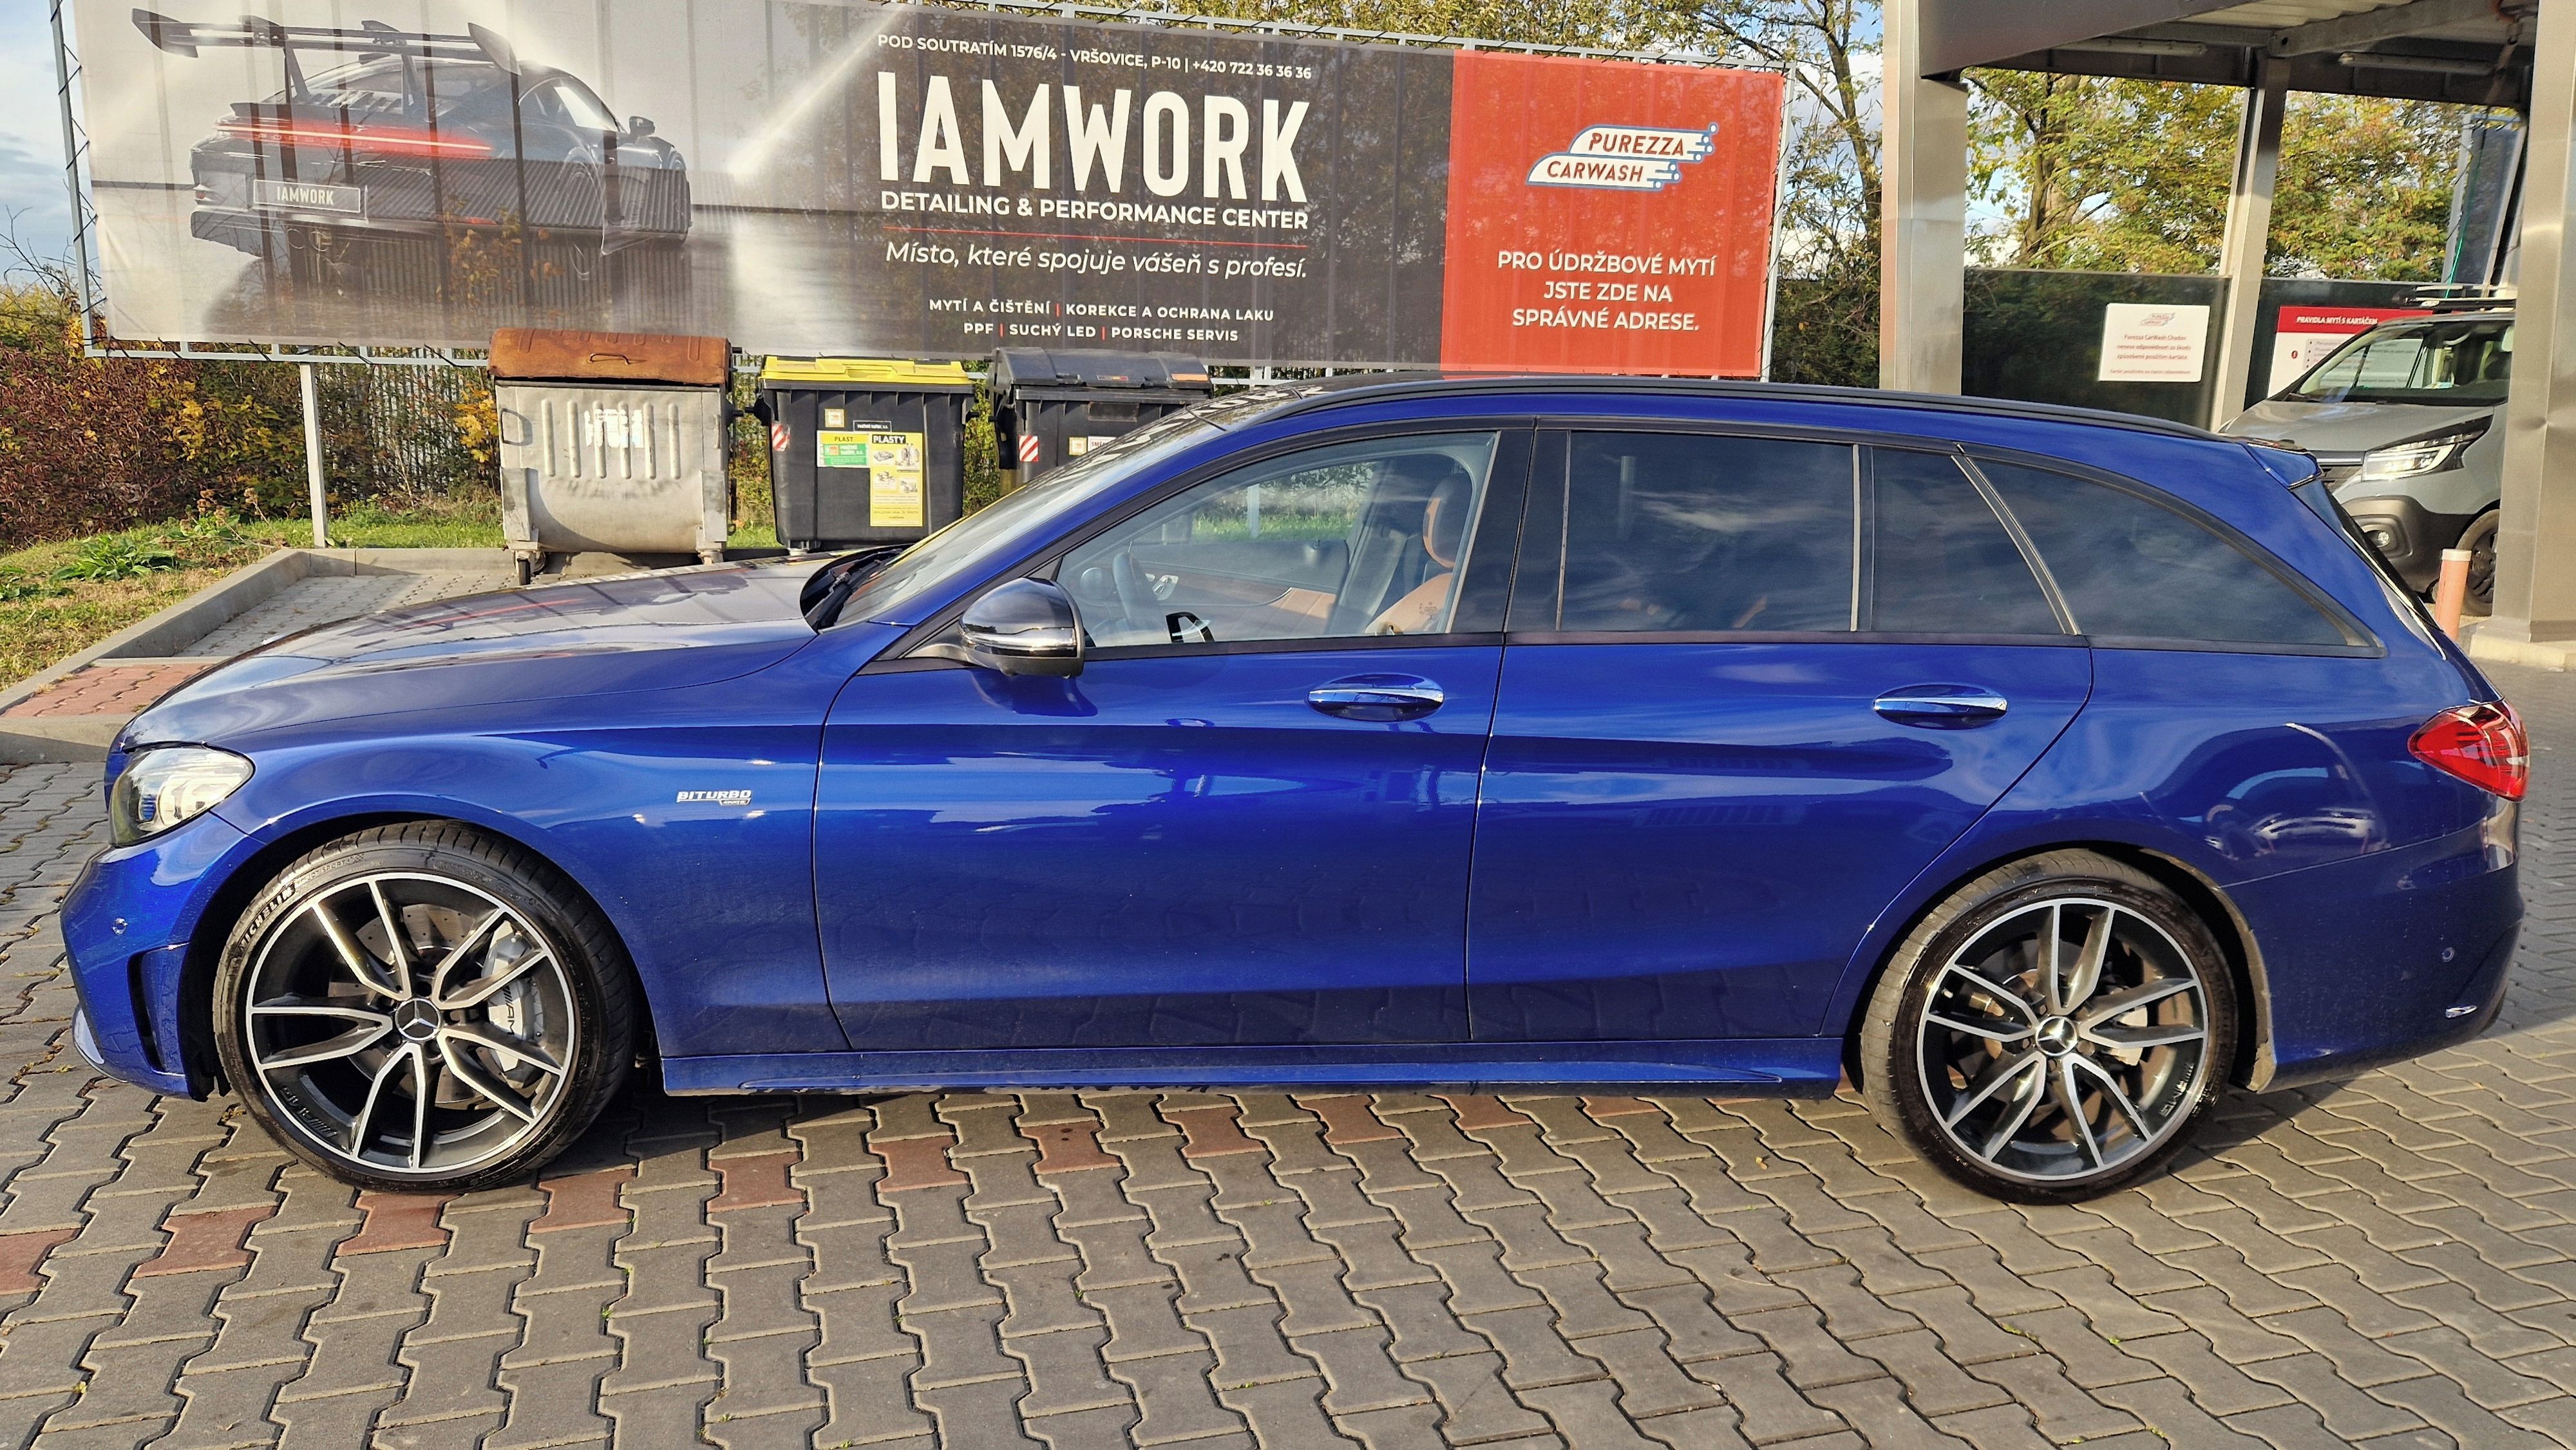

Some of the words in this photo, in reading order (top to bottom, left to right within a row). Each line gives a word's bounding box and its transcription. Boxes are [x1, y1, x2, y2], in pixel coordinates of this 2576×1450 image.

[878, 35, 913, 49] POD
[917, 37, 1007, 57] SOUTRATÍM
[1011, 44, 1057, 61] 1576/4
[1070, 48, 1148, 70] VRŠOVICE,
[1151, 56, 1181, 70] P-10
[1193, 60, 1226, 73] +420
[1229, 62, 1254, 75] 722
[1256, 63, 1273, 77] 36
[1276, 64, 1293, 78] 36
[1295, 66, 1312, 79] 36
[878, 71, 1310, 203] IAMWORK
[1589, 132, 1684, 156] PUREZZA
[1547, 160, 1643, 183] CARWASH
[276, 185, 335, 206] IAMWORK
[881, 191, 1010, 216] DETAILING
[1017, 199, 1034, 216] &
[1040, 199, 1217, 226] PERFORMANCE
[1222, 207, 1309, 230] CENTER
[886, 241, 960, 268] Místo,
[968, 244, 1032, 268] které
[1037, 249, 1126, 276] spojuje
[1133, 250, 1202, 274] vášeň
[1207, 259, 1220, 275] s
[1224, 254, 1307, 280] profesí.
[1497, 250, 1542, 270] PRO
[1548, 249, 1663, 274] ÚDRŽBOVÉ
[1668, 255, 1718, 276] MYTÍ
[1543, 281, 1592, 300] JSTE
[1596, 283, 1638, 301] ZDE
[1643, 285, 1673, 303] NA
[929, 298, 968, 313] MYTÍ
[972, 301, 984, 312] A
[989, 299, 1051, 315] ČIŠTĚNÍ
[1065, 303, 1137, 318] KOREKCE
[1141, 306, 1152, 318] A
[1157, 306, 1231, 321] OCHRANA
[1235, 308, 1274, 322] LAKU
[1512, 305, 1609, 328] SPRÁVNÉ
[1613, 312, 1700, 331] ADRESE.
[2326, 315, 2342, 324] MYTÍ
[963, 323, 994, 335] PPF
[1009, 323, 1061, 337] SUCHÝ
[1066, 326, 1097, 339] LED
[1111, 327, 1182, 341] PORSCHE
[1186, 330, 1238, 342] SERVIS
[873, 435, 905, 444] PLASTY
[677, 789, 752, 800] BITURBO
